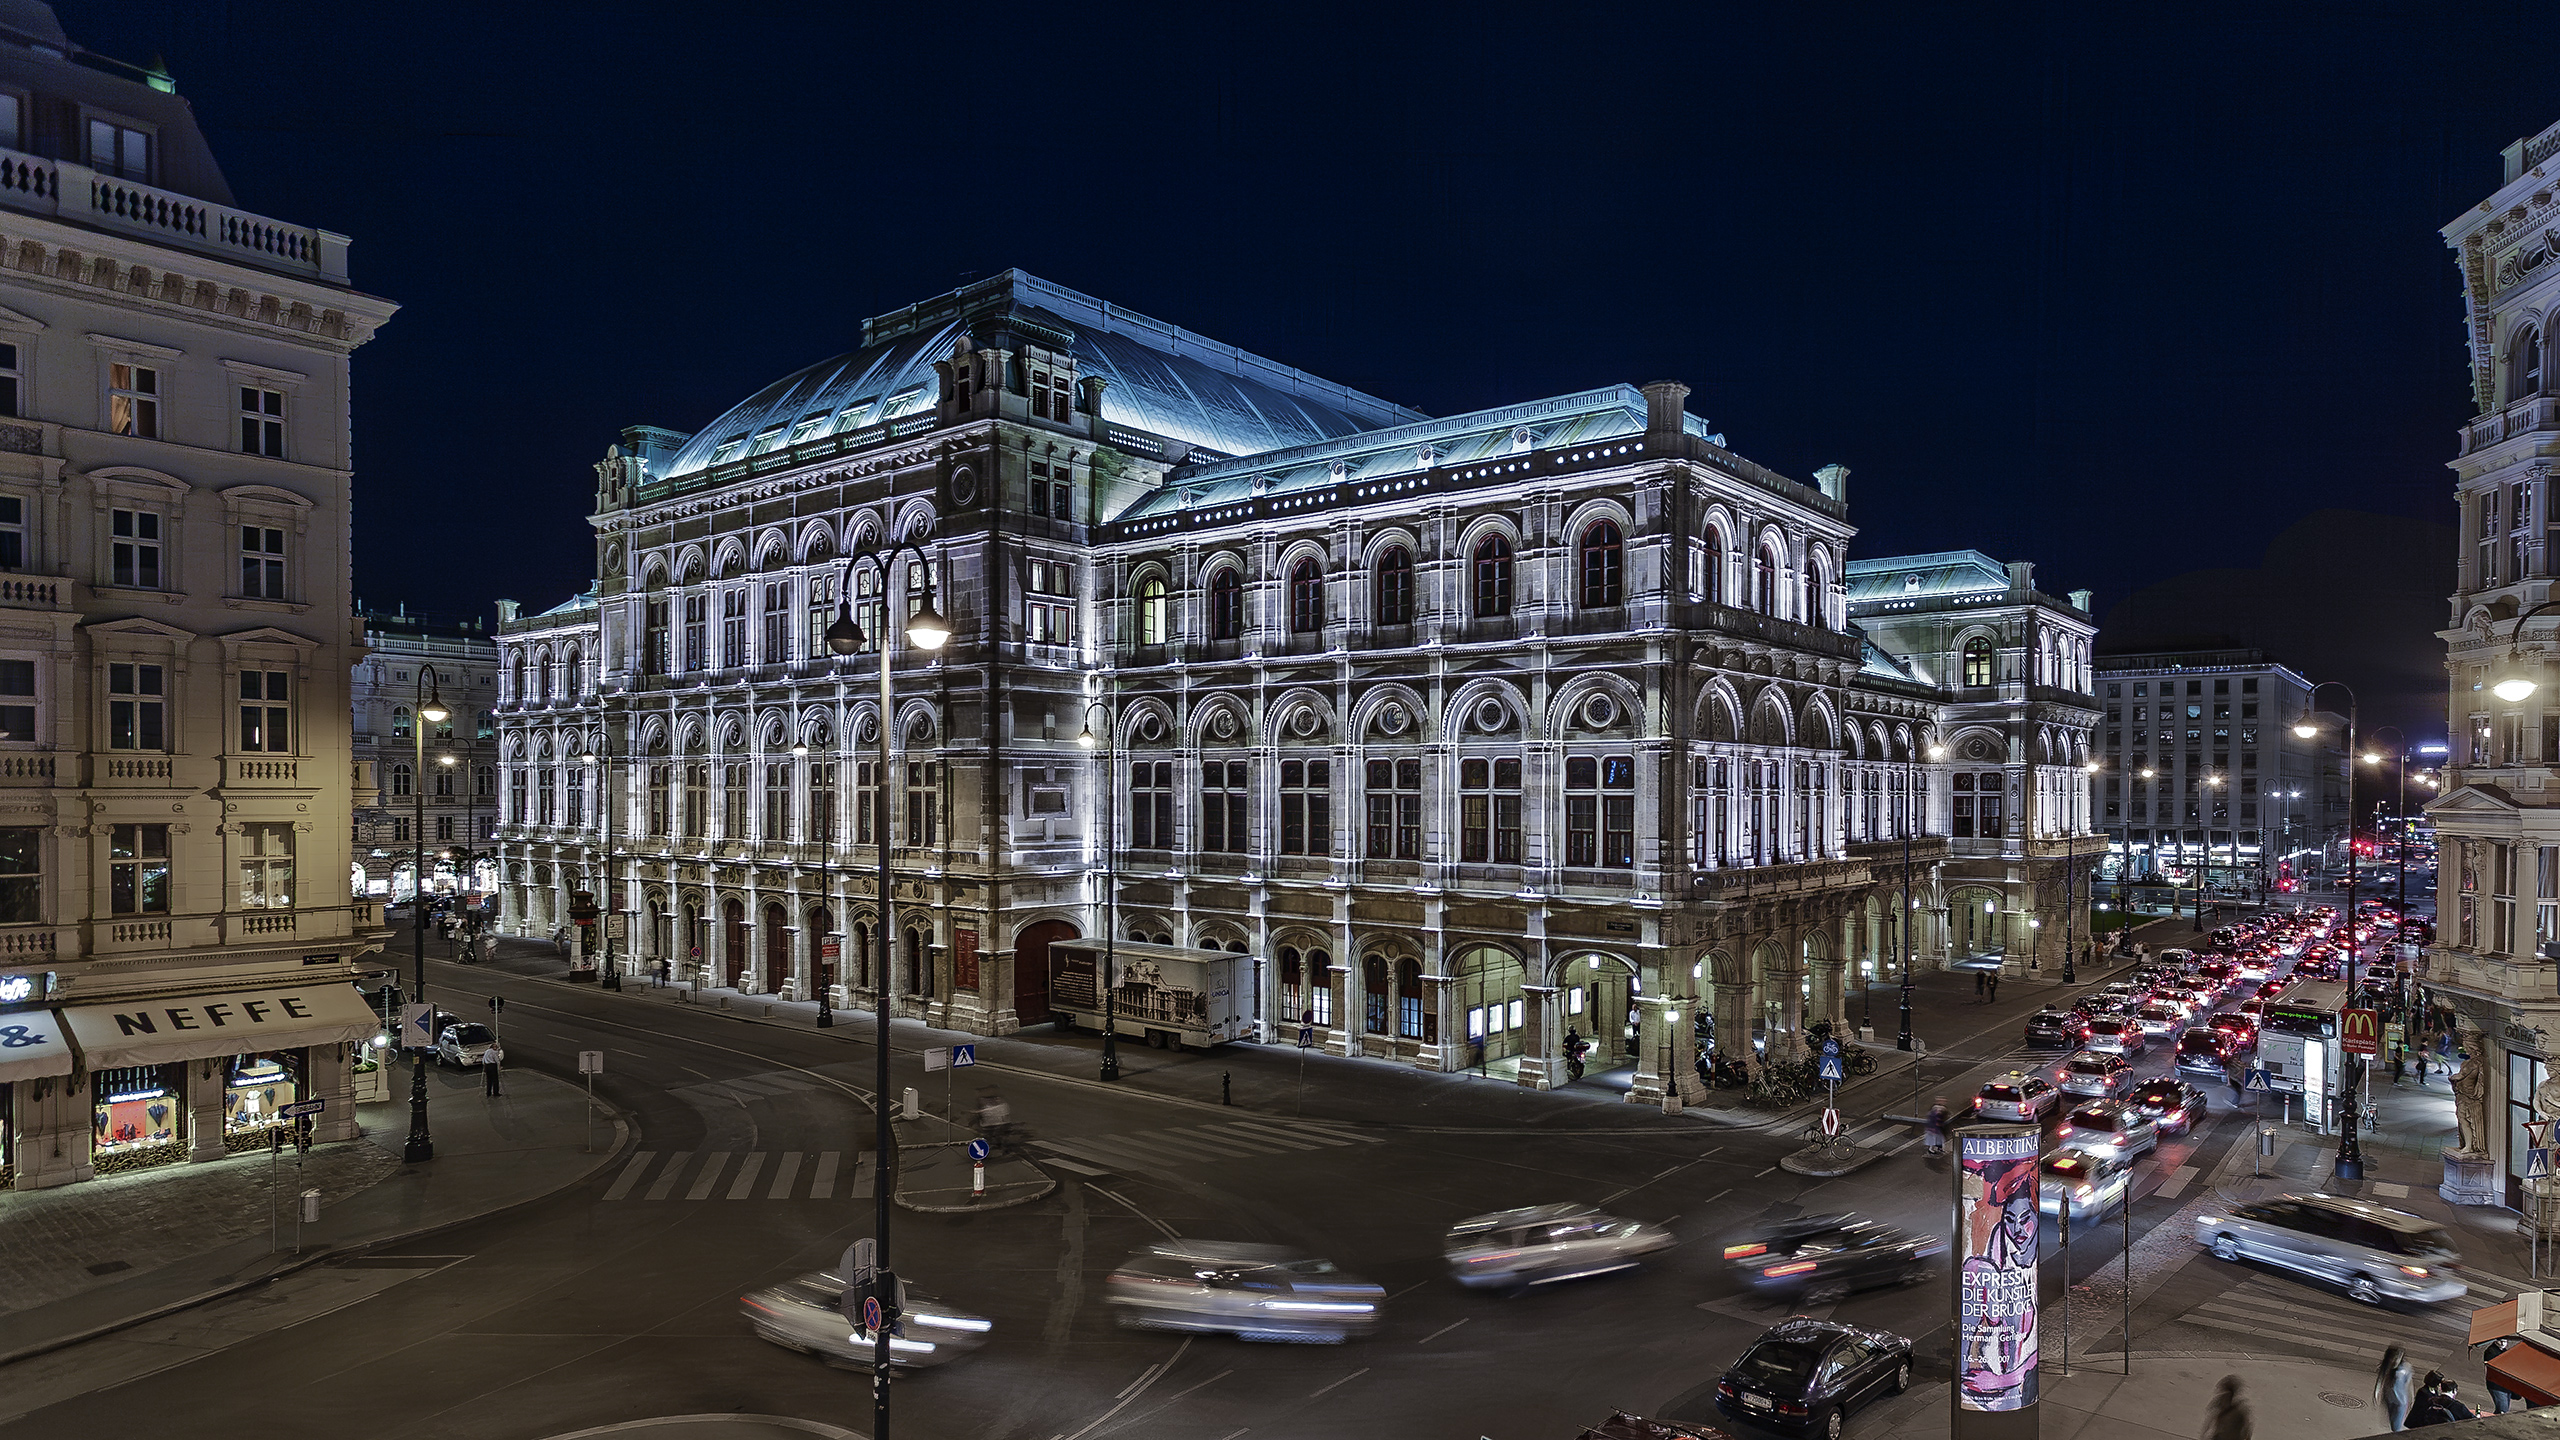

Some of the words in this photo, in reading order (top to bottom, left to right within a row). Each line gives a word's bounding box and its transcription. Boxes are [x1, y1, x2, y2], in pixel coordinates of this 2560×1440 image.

[0, 1026, 48, 1048] &
[113, 997, 314, 1036] NEFFE
[2342, 1037, 2376, 1046] Karlsplatz
[1963, 1136, 2039, 1155] ALBERTINA
[1962, 1287, 1984, 1302] DIE
[1987, 1283, 2036, 1303] KÜNSTLER
[1962, 1302, 1990, 1317] DER
[1992, 1299, 2032, 1318] BRÜCKE
[1962, 1323, 1976, 1332] Die
[1977, 1324, 2015, 1334] Sammlung
